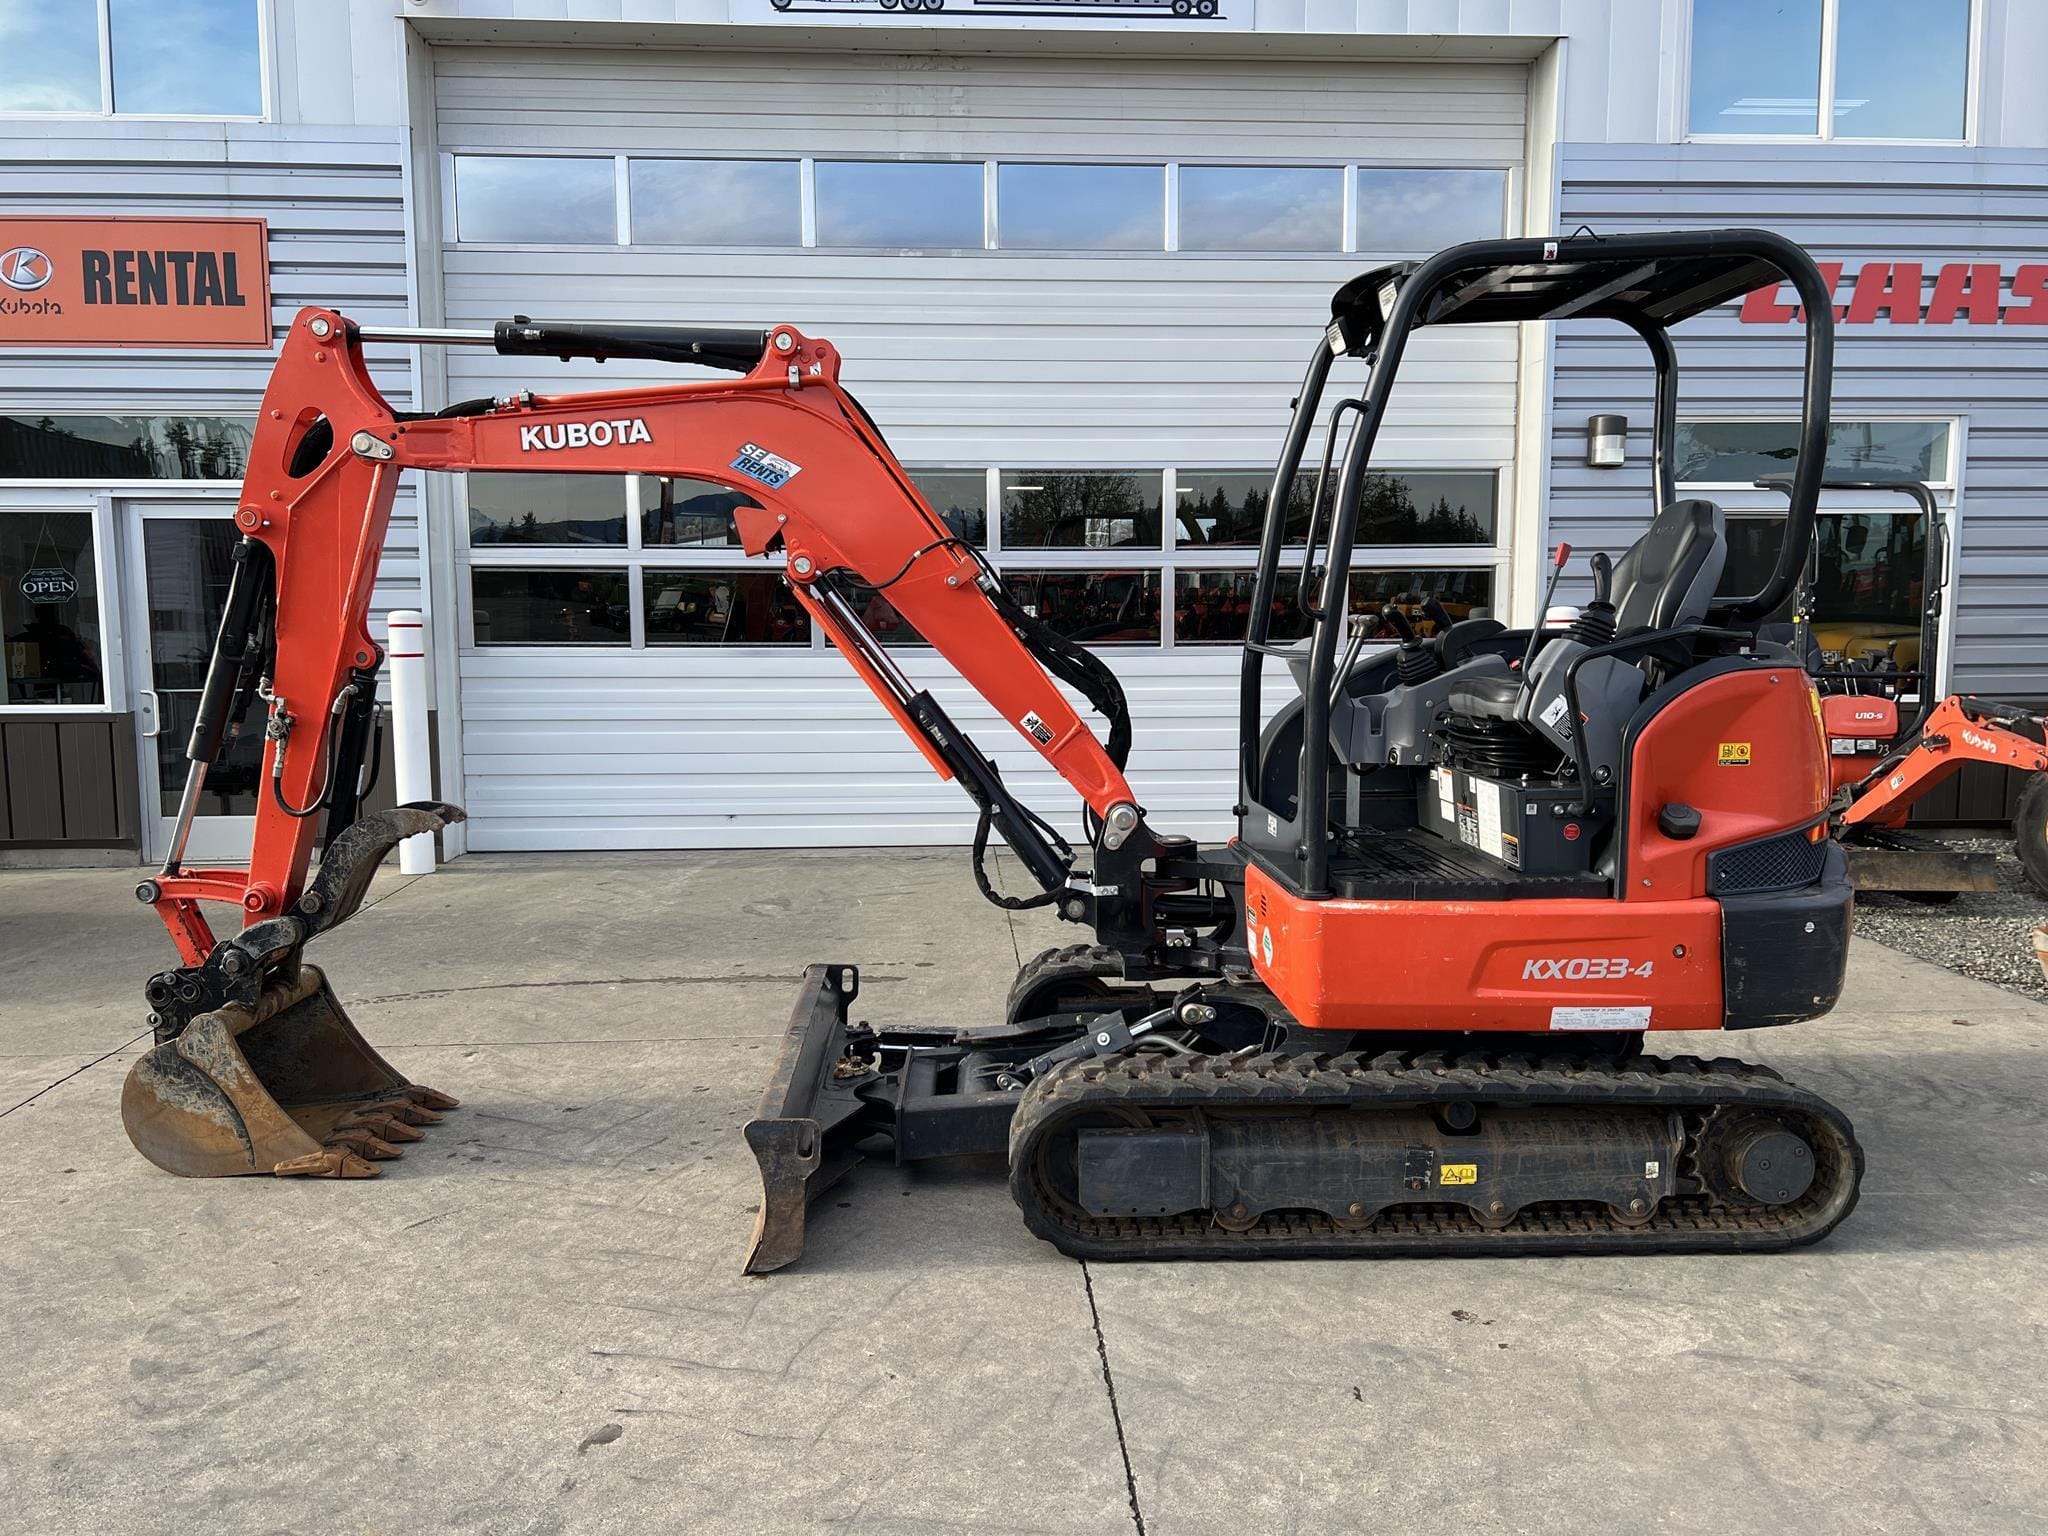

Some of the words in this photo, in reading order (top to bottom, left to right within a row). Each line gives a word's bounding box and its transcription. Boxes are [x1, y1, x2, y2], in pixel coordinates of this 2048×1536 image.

[82, 250, 246, 306] RENTAL
[0, 298, 62, 315] Kubota
[519, 418, 653, 451] KUBOTA
[736, 457, 784, 484] RENTS
[22, 580, 75, 594] OPEN
[1521, 958, 1654, 980] KX033-4
